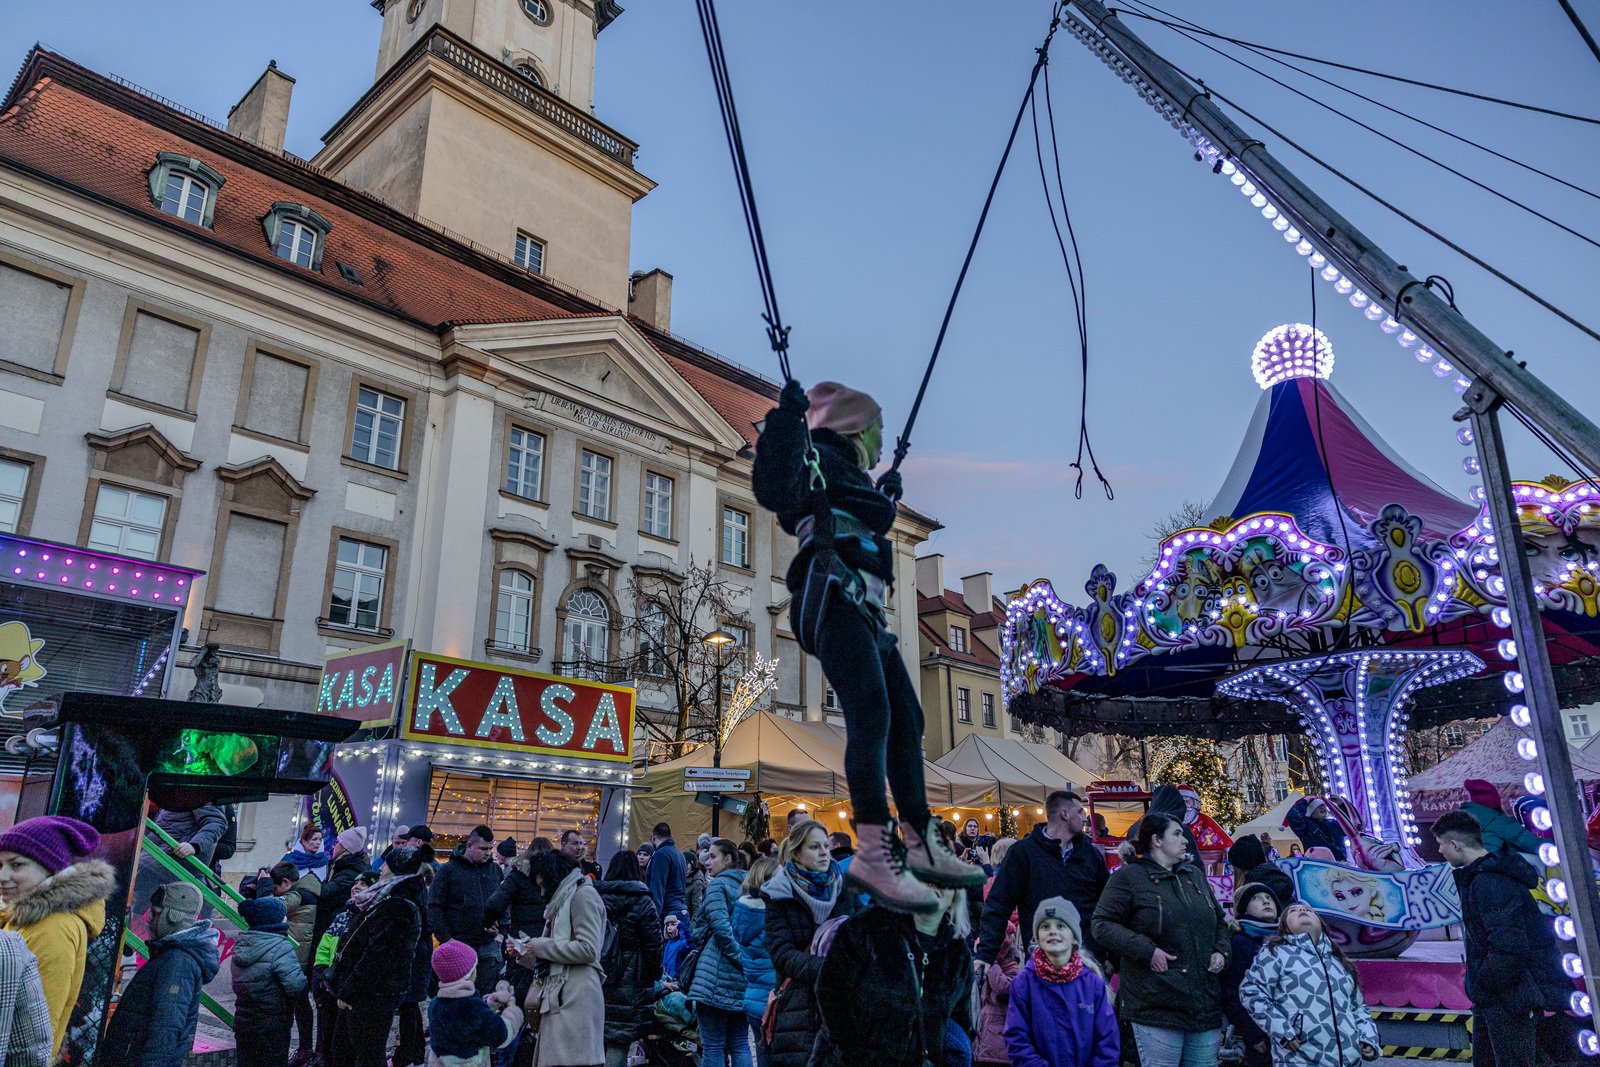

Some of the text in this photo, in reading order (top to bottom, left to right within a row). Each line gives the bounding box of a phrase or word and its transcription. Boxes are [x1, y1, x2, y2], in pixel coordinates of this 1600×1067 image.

[551, 396, 576, 412] URBEM
[620, 423, 657, 441] DISTORTUS
[602, 424, 630, 439] STRUXIT
[317, 662, 394, 713] KASA
[413, 663, 626, 753] KASA
[329, 777, 346, 806] DZINNY
[1421, 800, 1462, 812] RARYT
